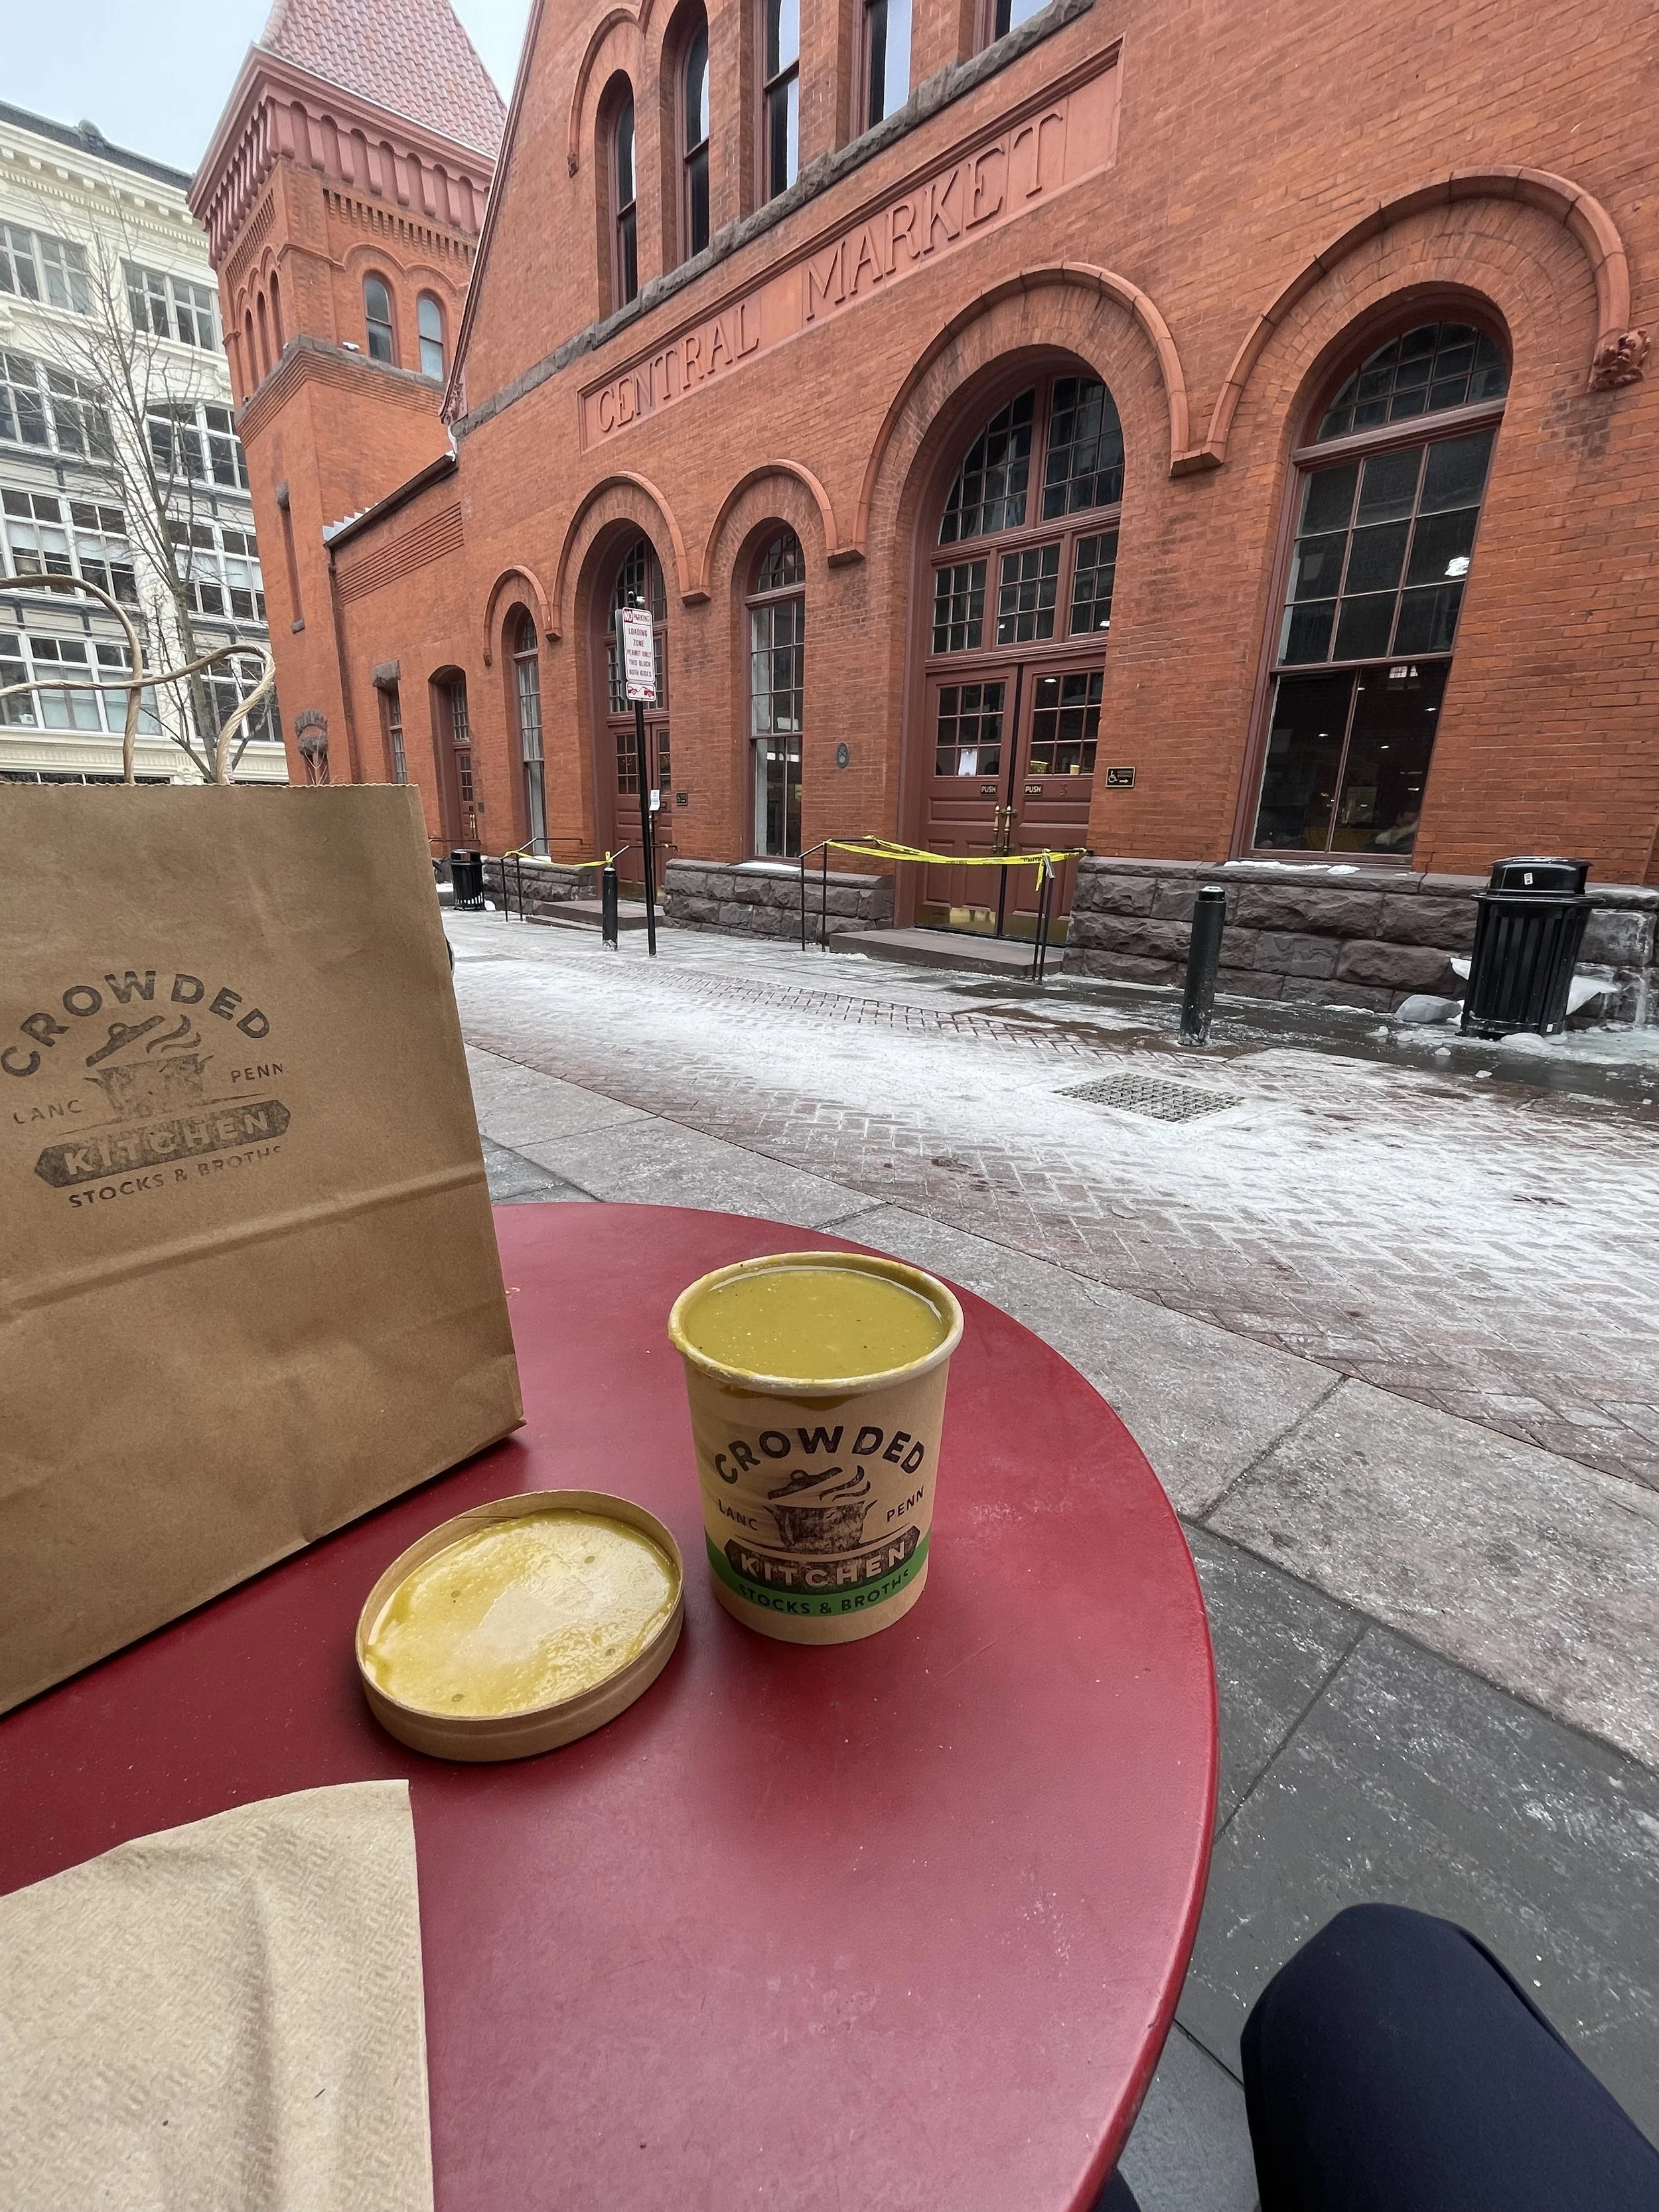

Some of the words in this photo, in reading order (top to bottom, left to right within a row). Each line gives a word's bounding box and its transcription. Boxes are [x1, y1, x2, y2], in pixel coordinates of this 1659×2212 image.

[597, 303, 760, 433] CENTRAL
[804, 112, 1064, 321] MARKET
[624, 610, 632, 622] NO
[633, 614, 650, 623] PARKING
[628, 627, 648, 636] LOADING
[1, 970, 271, 1078] CROWDED
[13, 1099, 84, 1124] LANC
[230, 1062, 286, 1083] PENN
[64, 1110, 269, 1176] KITCHEN
[68, 1173, 165, 1209] STOCKS
[175, 1168, 188, 1182] &
[715, 1425, 925, 1485] CROWDED
[717, 1498, 760, 1532] LANC
[886, 1485, 924, 1522] PENN
[741, 1539, 906, 1587] KITCHEN
[739, 1582, 811, 1615] STOCKS
[819, 1601, 832, 1614] &
